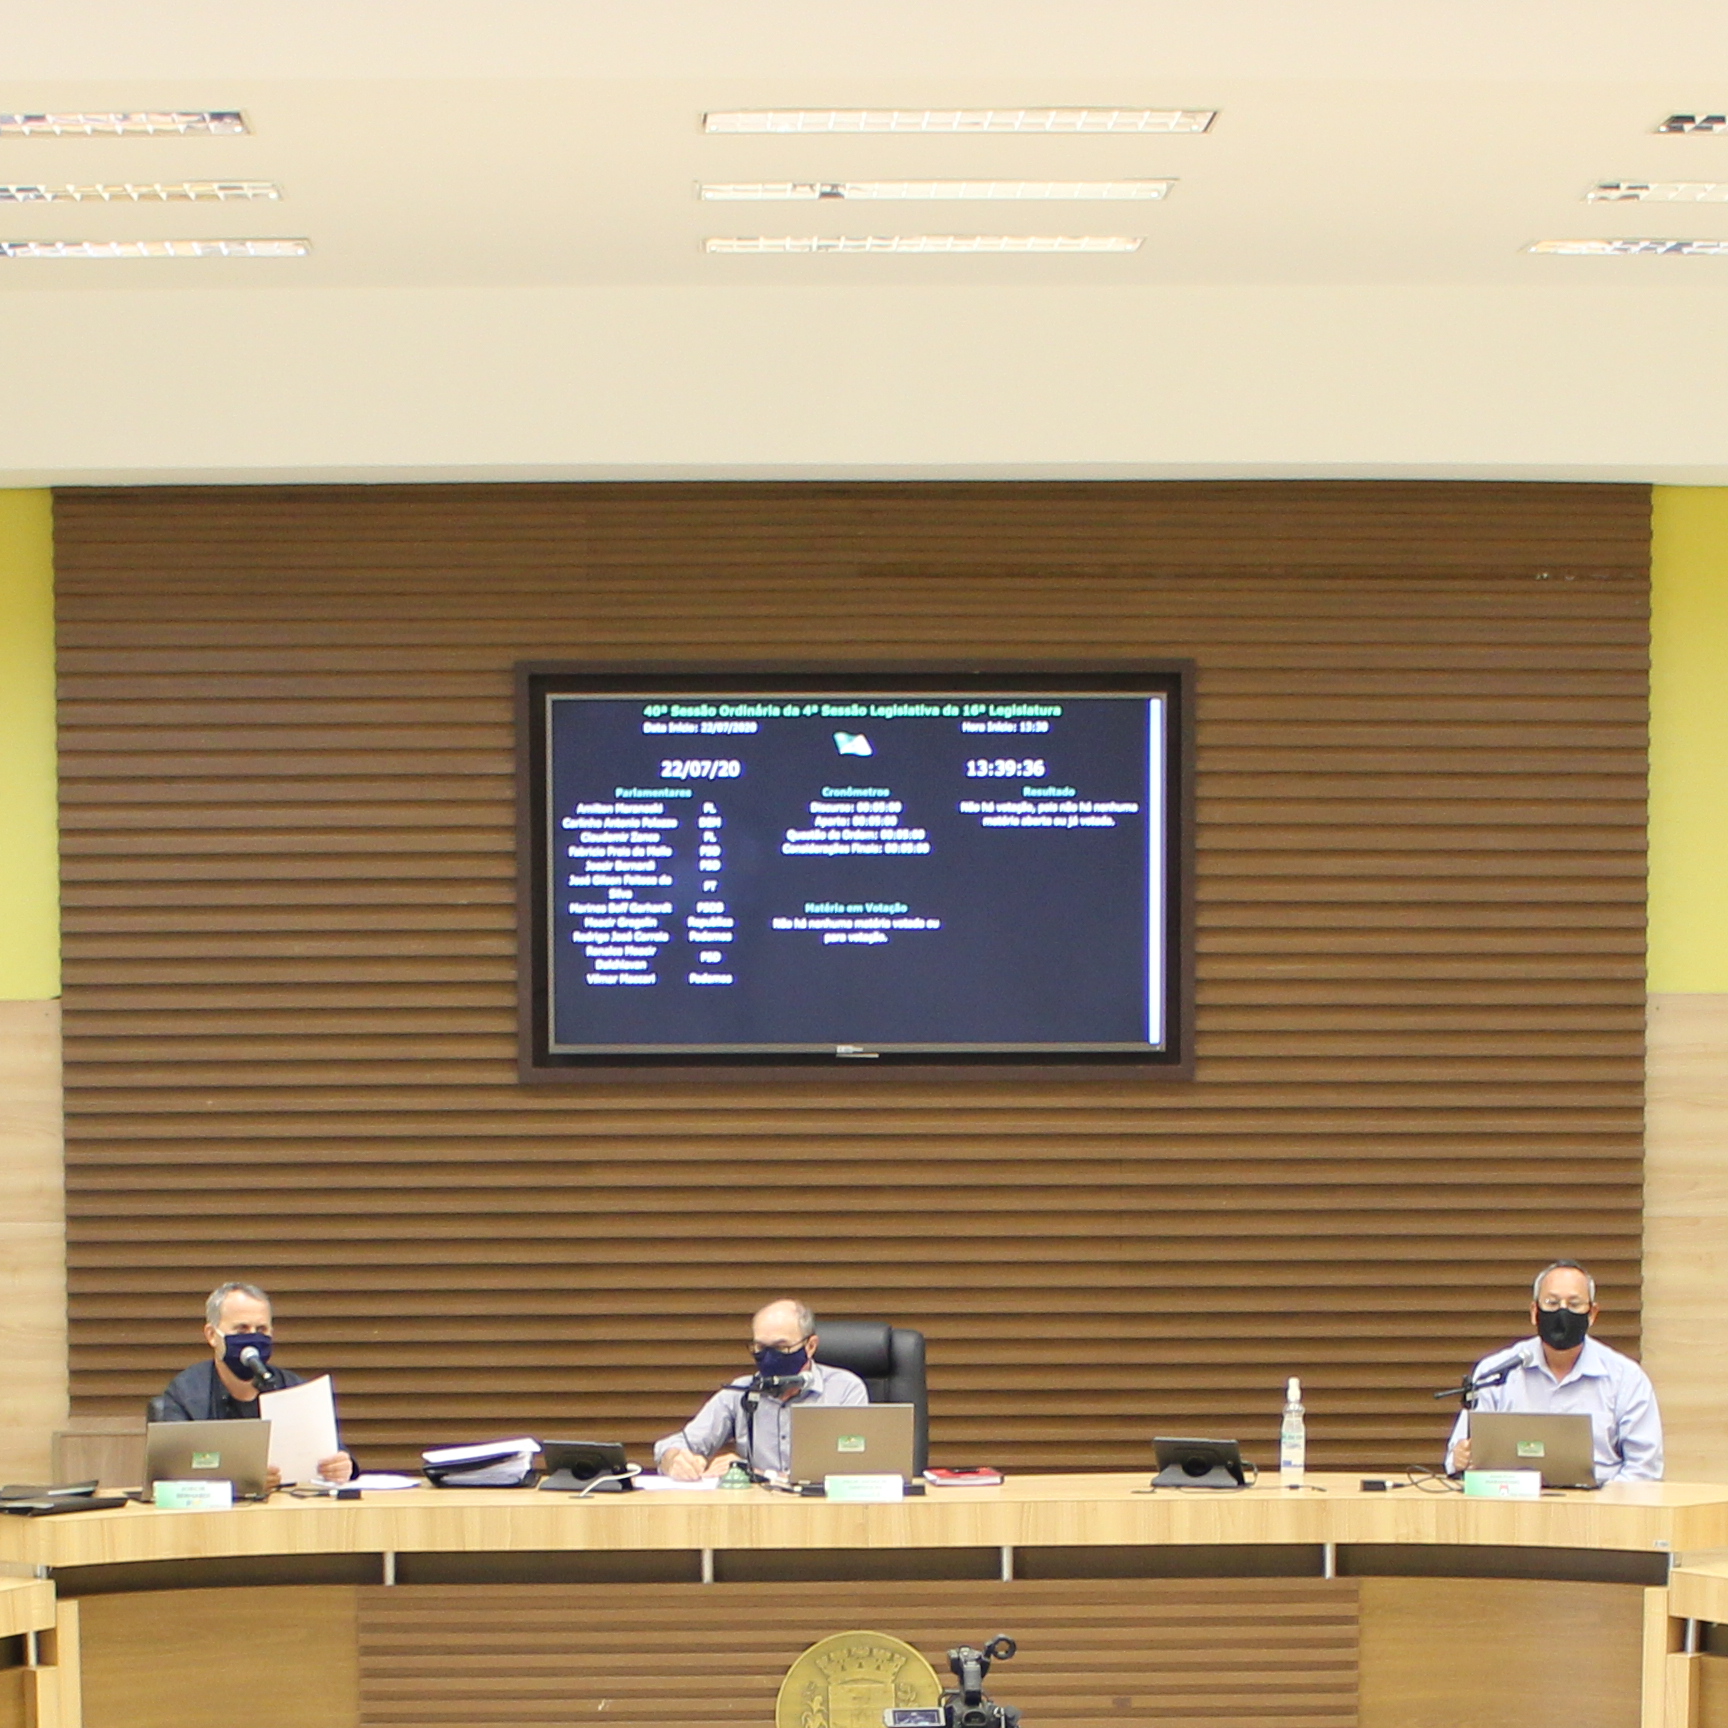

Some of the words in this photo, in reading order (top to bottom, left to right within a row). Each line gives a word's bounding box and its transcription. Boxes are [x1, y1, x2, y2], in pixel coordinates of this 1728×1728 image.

[670, 704, 717, 718] Sessão
[719, 704, 780, 718] Ordinária
[782, 704, 800, 717] da
[821, 704, 867, 717] Sessão
[870, 704, 940, 719] Legislativa
[943, 704, 960, 717] da
[989, 704, 1062, 719] Legislatura
[661, 759, 741, 779] 22/07/20
[966, 759, 1046, 777] 13:39:36
[615, 787, 692, 798] Parlamentares
[822, 786, 890, 797] Cronômetros
[1023, 786, 1076, 797] Resultado
[804, 903, 844, 913] Matéria
[846, 904, 863, 913] em
[865, 903, 908, 914] Votação
